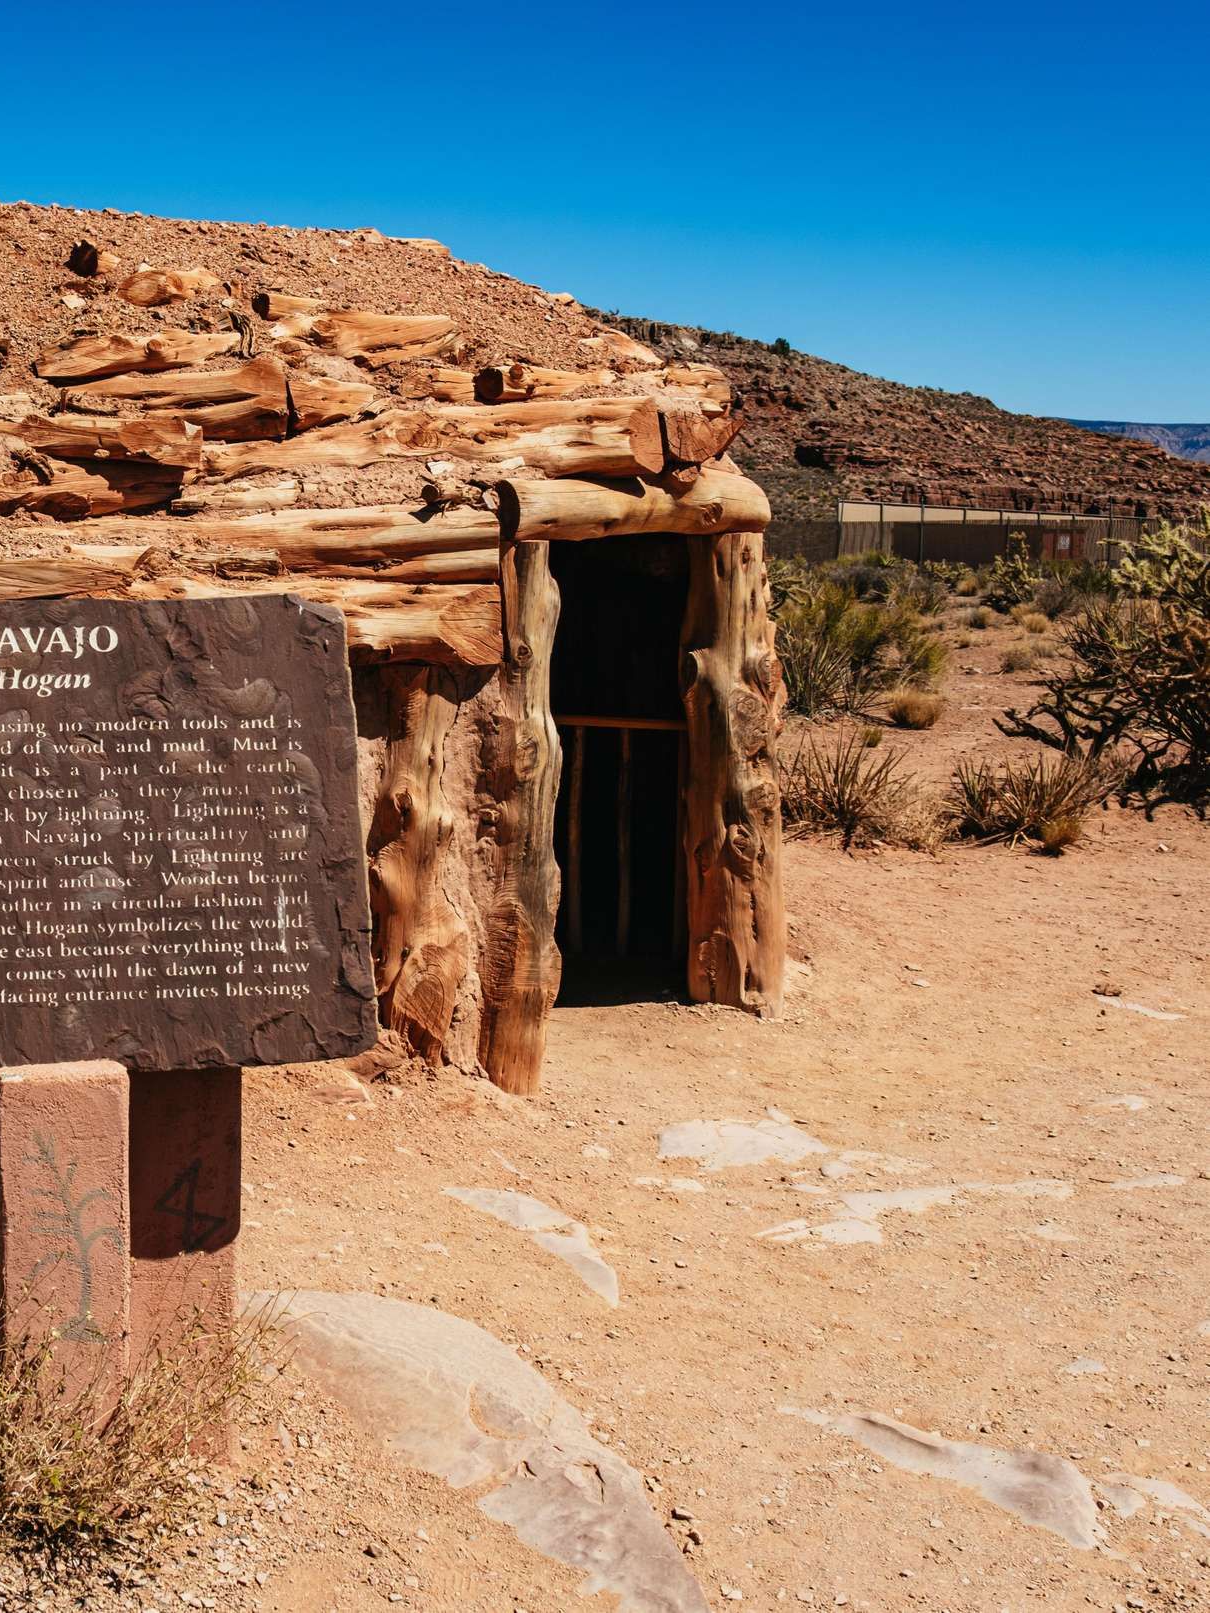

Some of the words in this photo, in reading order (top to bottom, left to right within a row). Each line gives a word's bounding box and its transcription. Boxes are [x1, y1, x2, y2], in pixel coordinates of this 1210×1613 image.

[58, 721, 83, 732] no
[95, 716, 170, 731] modern
[182, 716, 229, 730] tools
[240, 715, 275, 729] and
[287, 715, 302, 729] is
[23, 740, 42, 755] of
[54, 740, 105, 754] wood
[116, 738, 151, 753] and
[232, 737, 277, 752] Mud
[287, 737, 303, 750] is
[1, 763, 14, 778] it
[35, 762, 50, 777] is
[71, 765, 80, 776] a
[100, 763, 139, 781] part
[159, 761, 178, 775] of
[198, 762, 227, 774] the
[246, 758, 297, 773] earth
[8, 784, 79, 800] chosen
[99, 787, 119, 798] as
[139, 783, 182, 802] they
[202, 784, 249, 797] must
[271, 784, 303, 795] not
[25, 807, 47, 826] by
[58, 806, 150, 826] lightning.
[173, 803, 265, 820] Lightning
[274, 802, 289, 815] is
[298, 804, 309, 815] a
[25, 830, 102, 847] Navajo
[123, 828, 248, 846] spirituality
[269, 825, 306, 840] and
[54, 851, 114, 866] struck
[131, 851, 153, 869] by
[172, 849, 263, 867] Lightning
[279, 849, 309, 861] are
[59, 875, 94, 889] and
[161, 871, 238, 886] Wooden
[249, 870, 308, 884] beams
[64, 898, 81, 911] in
[91, 899, 102, 910] a
[112, 894, 182, 910] circular
[194, 891, 263, 907] fashion
[273, 891, 308, 906] and
[26, 920, 89, 939] Hogan
[98, 917, 202, 936] symbolizes
[212, 916, 240, 930] the
[15, 944, 53, 959] east
[60, 942, 134, 957] because
[141, 939, 243, 959] everything
[250, 939, 287, 952] that
[295, 936, 309, 951] is
[6, 968, 66, 982] comes
[76, 964, 117, 980] with
[127, 963, 157, 977] the
[166, 960, 216, 977] dawn
[226, 959, 245, 974] of
[253, 963, 263, 974] a
[272, 961, 310, 973] new
[0, 990, 58, 1008] facing
[65, 987, 148, 1002] entrance
[156, 985, 218, 1000] invites
[226, 982, 310, 1000] blessings
